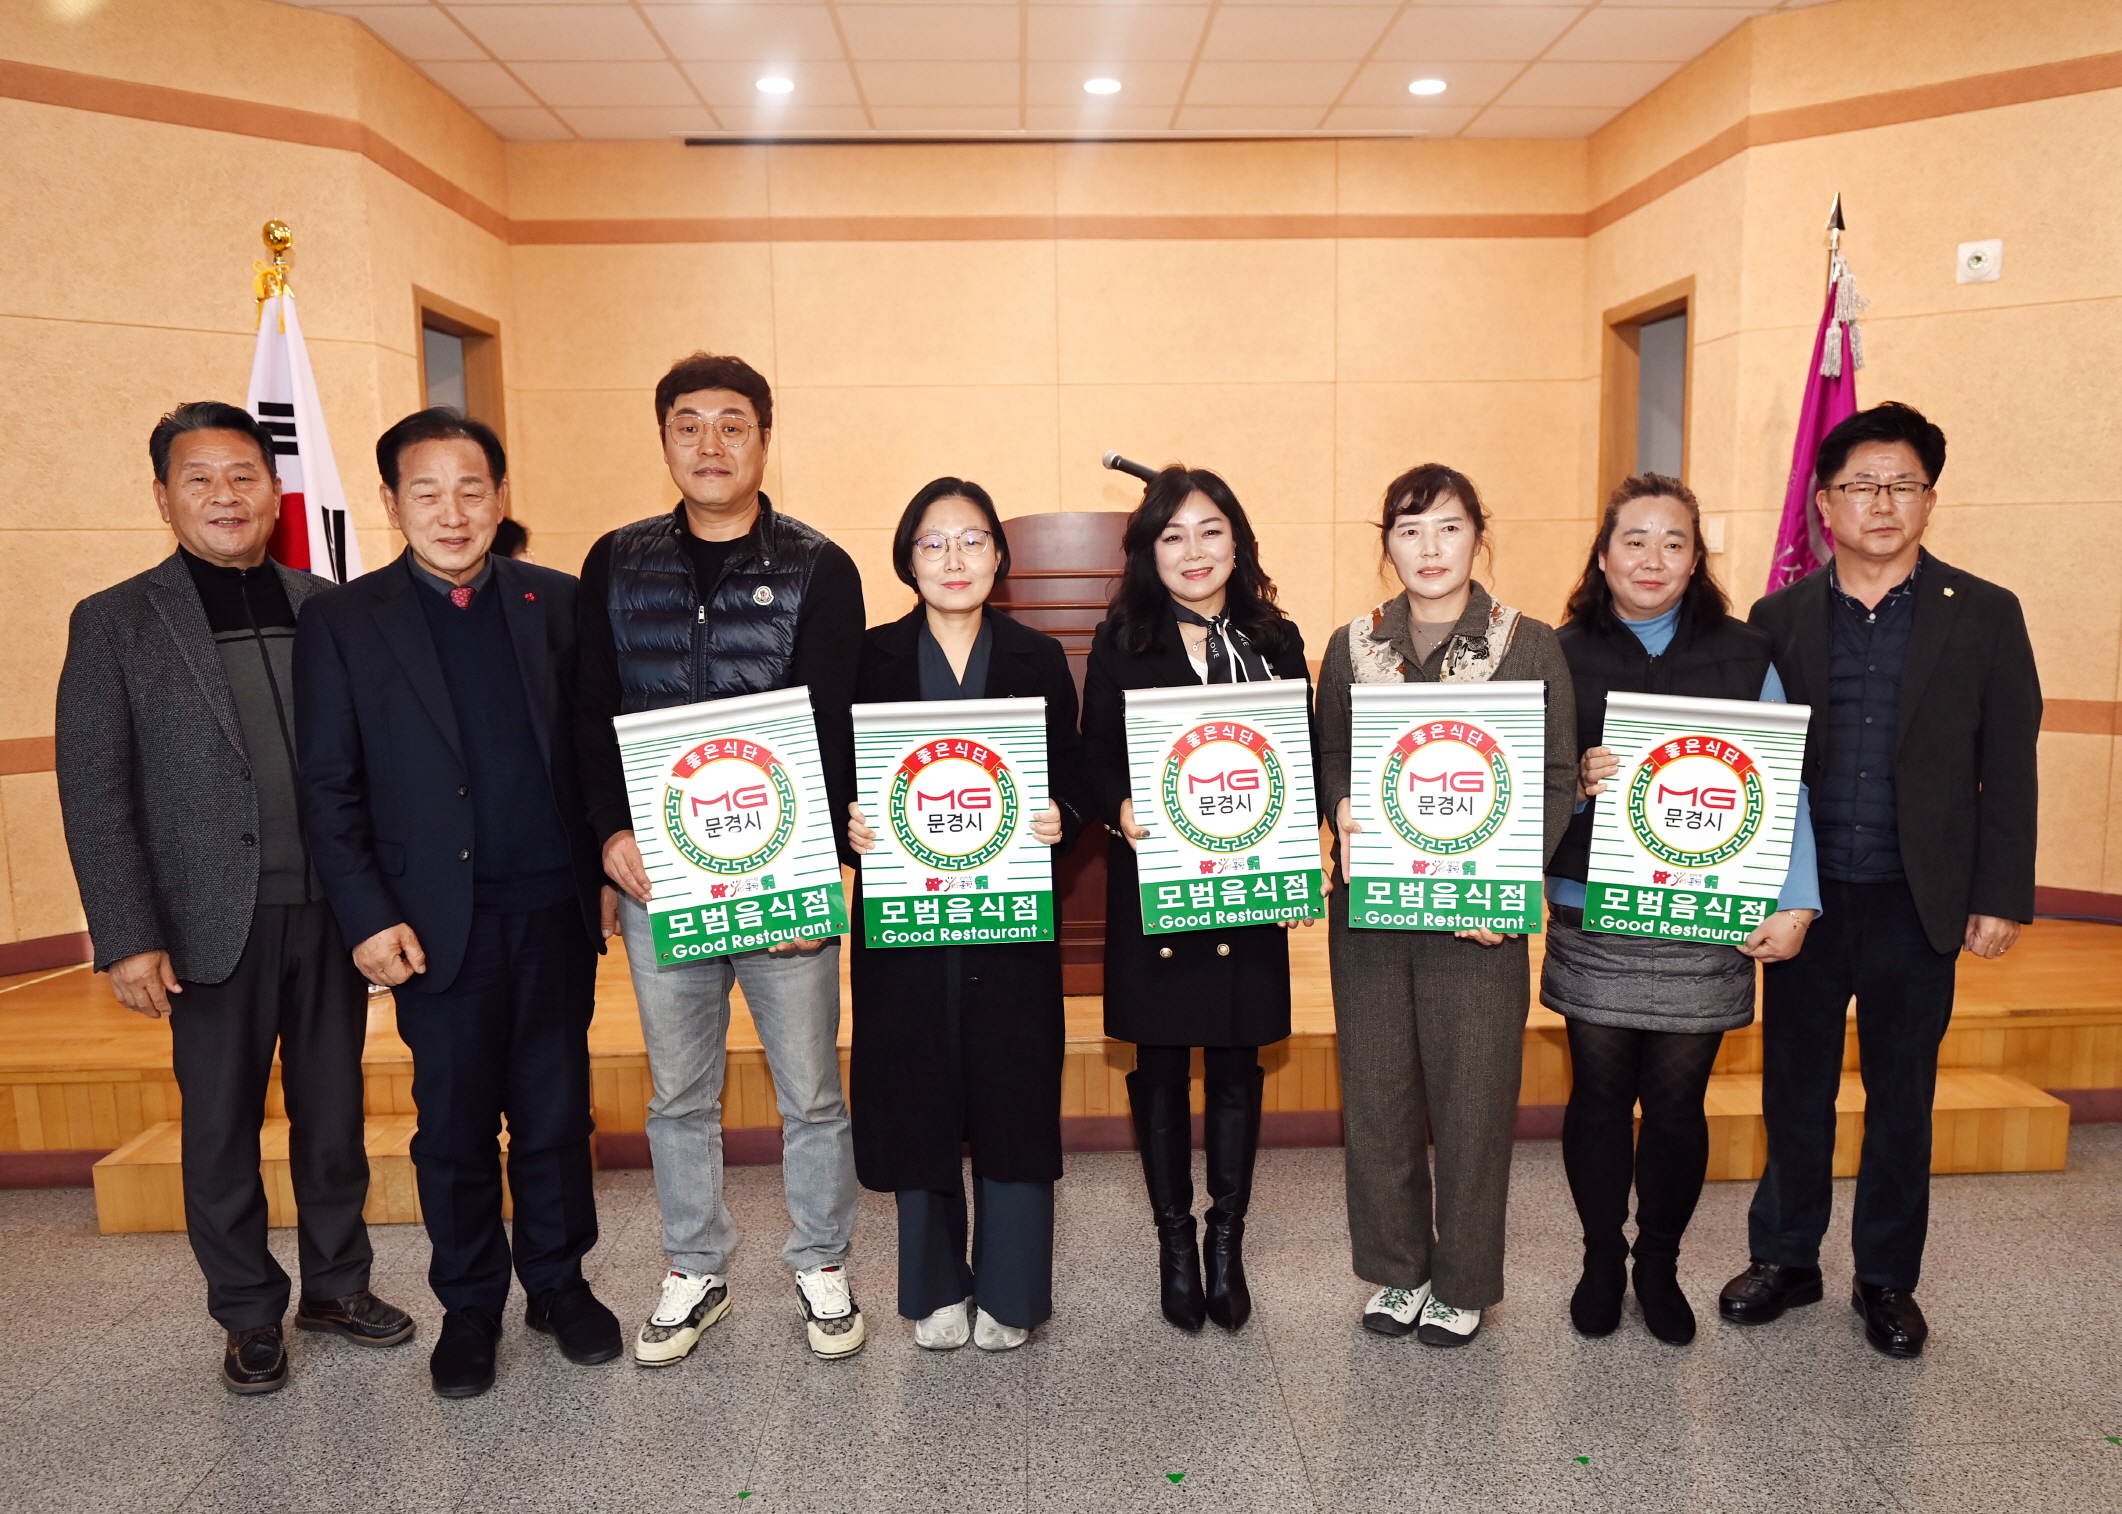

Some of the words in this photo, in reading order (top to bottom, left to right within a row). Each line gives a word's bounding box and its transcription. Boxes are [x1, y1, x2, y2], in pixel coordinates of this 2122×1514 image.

[1208, 637, 1220, 659] LOVE
[1188, 769, 1259, 794] MG
[1409, 771, 1484, 793] MG
[690, 784, 768, 817] MG
[917, 787, 991, 811] MG
[1199, 794, 1252, 816] 문경시
[1417, 795, 1473, 816] 문경시
[1657, 783, 1737, 810] MG
[705, 811, 762, 838] 문경시
[927, 812, 982, 833] 문경시
[1664, 808, 1723, 831] 문경시
[1156, 873, 1309, 909] 모범음식점
[1364, 881, 1526, 911] 모범음식점
[668, 887, 830, 938] 모범음식점
[880, 894, 1038, 925] 모범음식점
[1159, 912, 1211, 929] Good
[1215, 903, 1309, 923] Restaurant
[1365, 910, 1418, 926] Good
[1423, 912, 1524, 929] Restaurant
[1600, 887, 1768, 927] 모범음식점
[672, 935, 727, 959] Good
[732, 919, 832, 948] Restaurant
[881, 930, 935, 944] Good
[940, 924, 1038, 941] Restaurant
[1600, 915, 1654, 933] Good
[1659, 920, 1751, 942] Restaura
